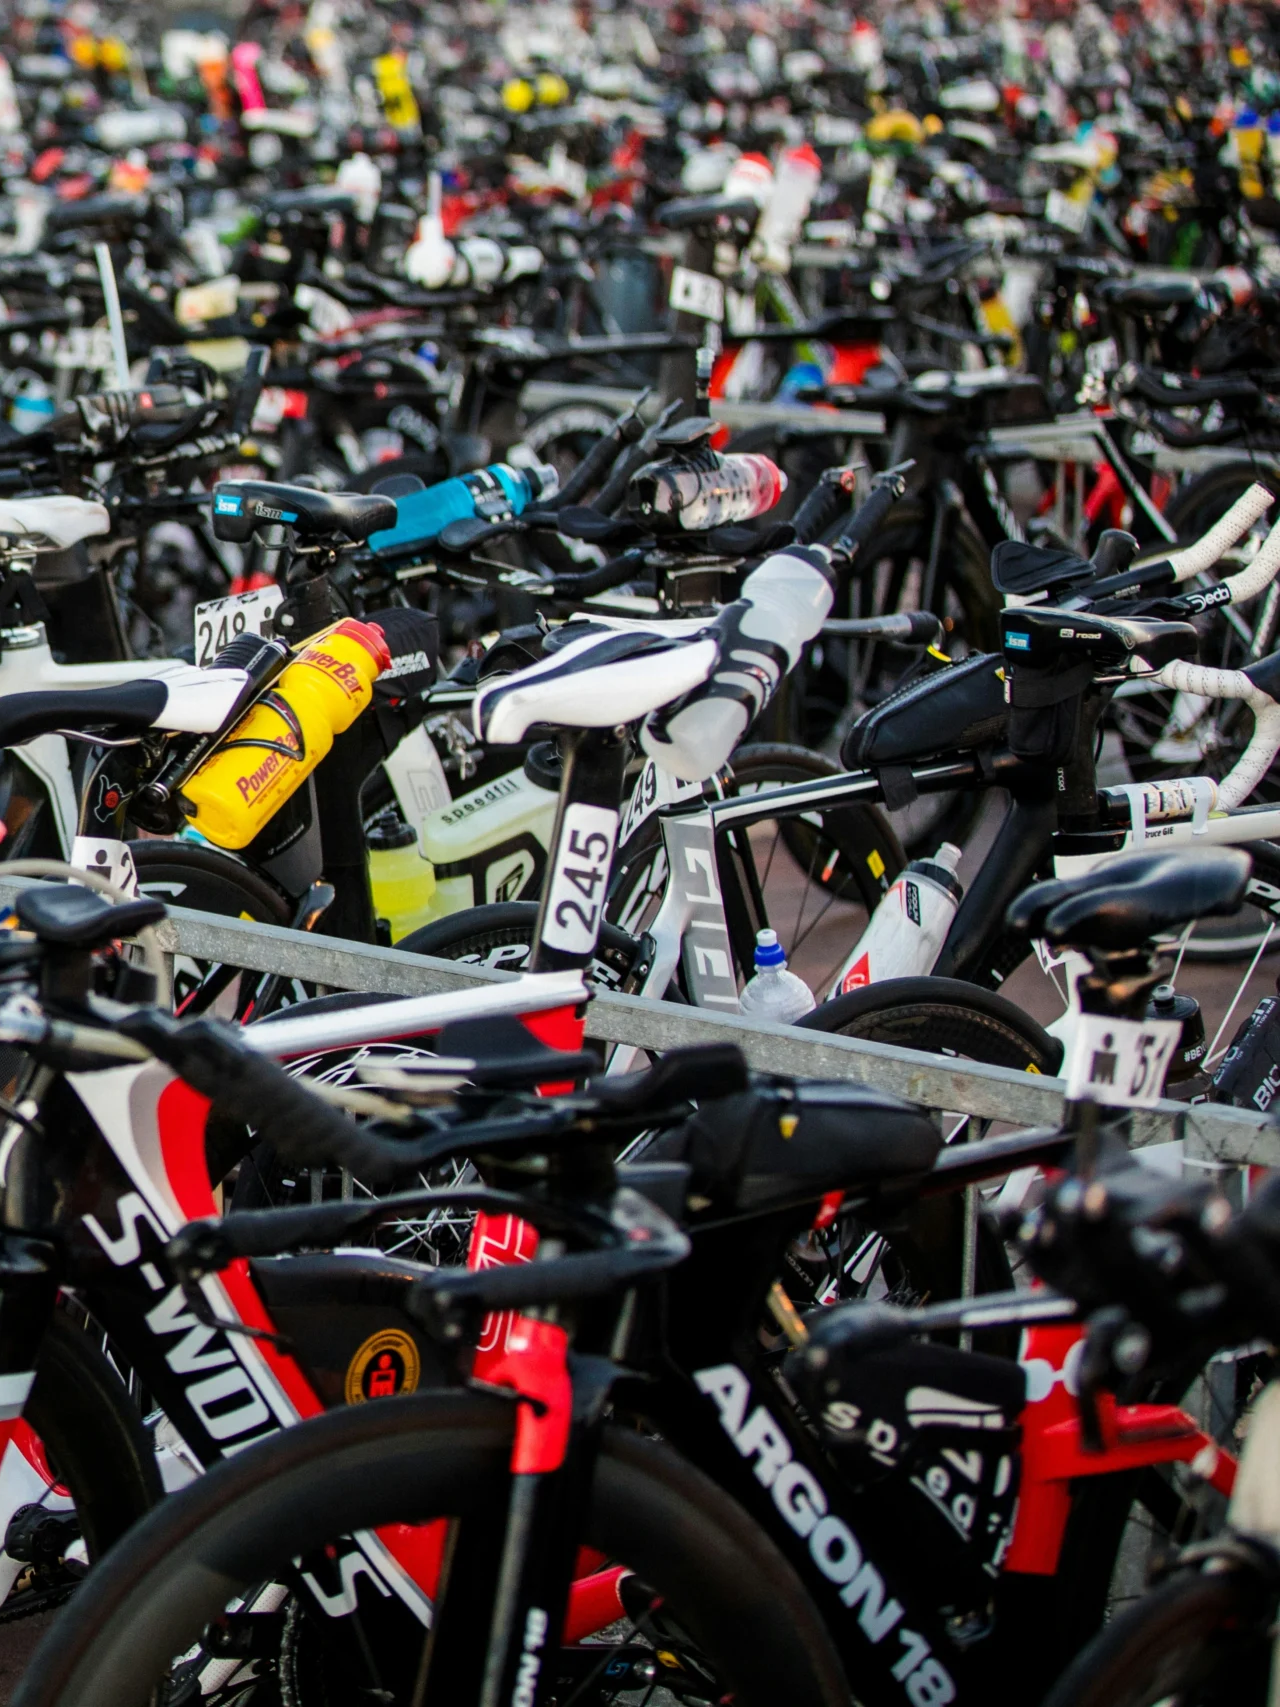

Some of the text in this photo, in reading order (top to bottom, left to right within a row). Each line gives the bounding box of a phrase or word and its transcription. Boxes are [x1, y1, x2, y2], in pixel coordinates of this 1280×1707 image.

[255, 501, 283, 520] ism
[441, 779, 519, 825] speedfil
[554, 829, 609, 934] 245
[693, 1363, 904, 1645] ARGON
[890, 1627, 957, 1707] 18
